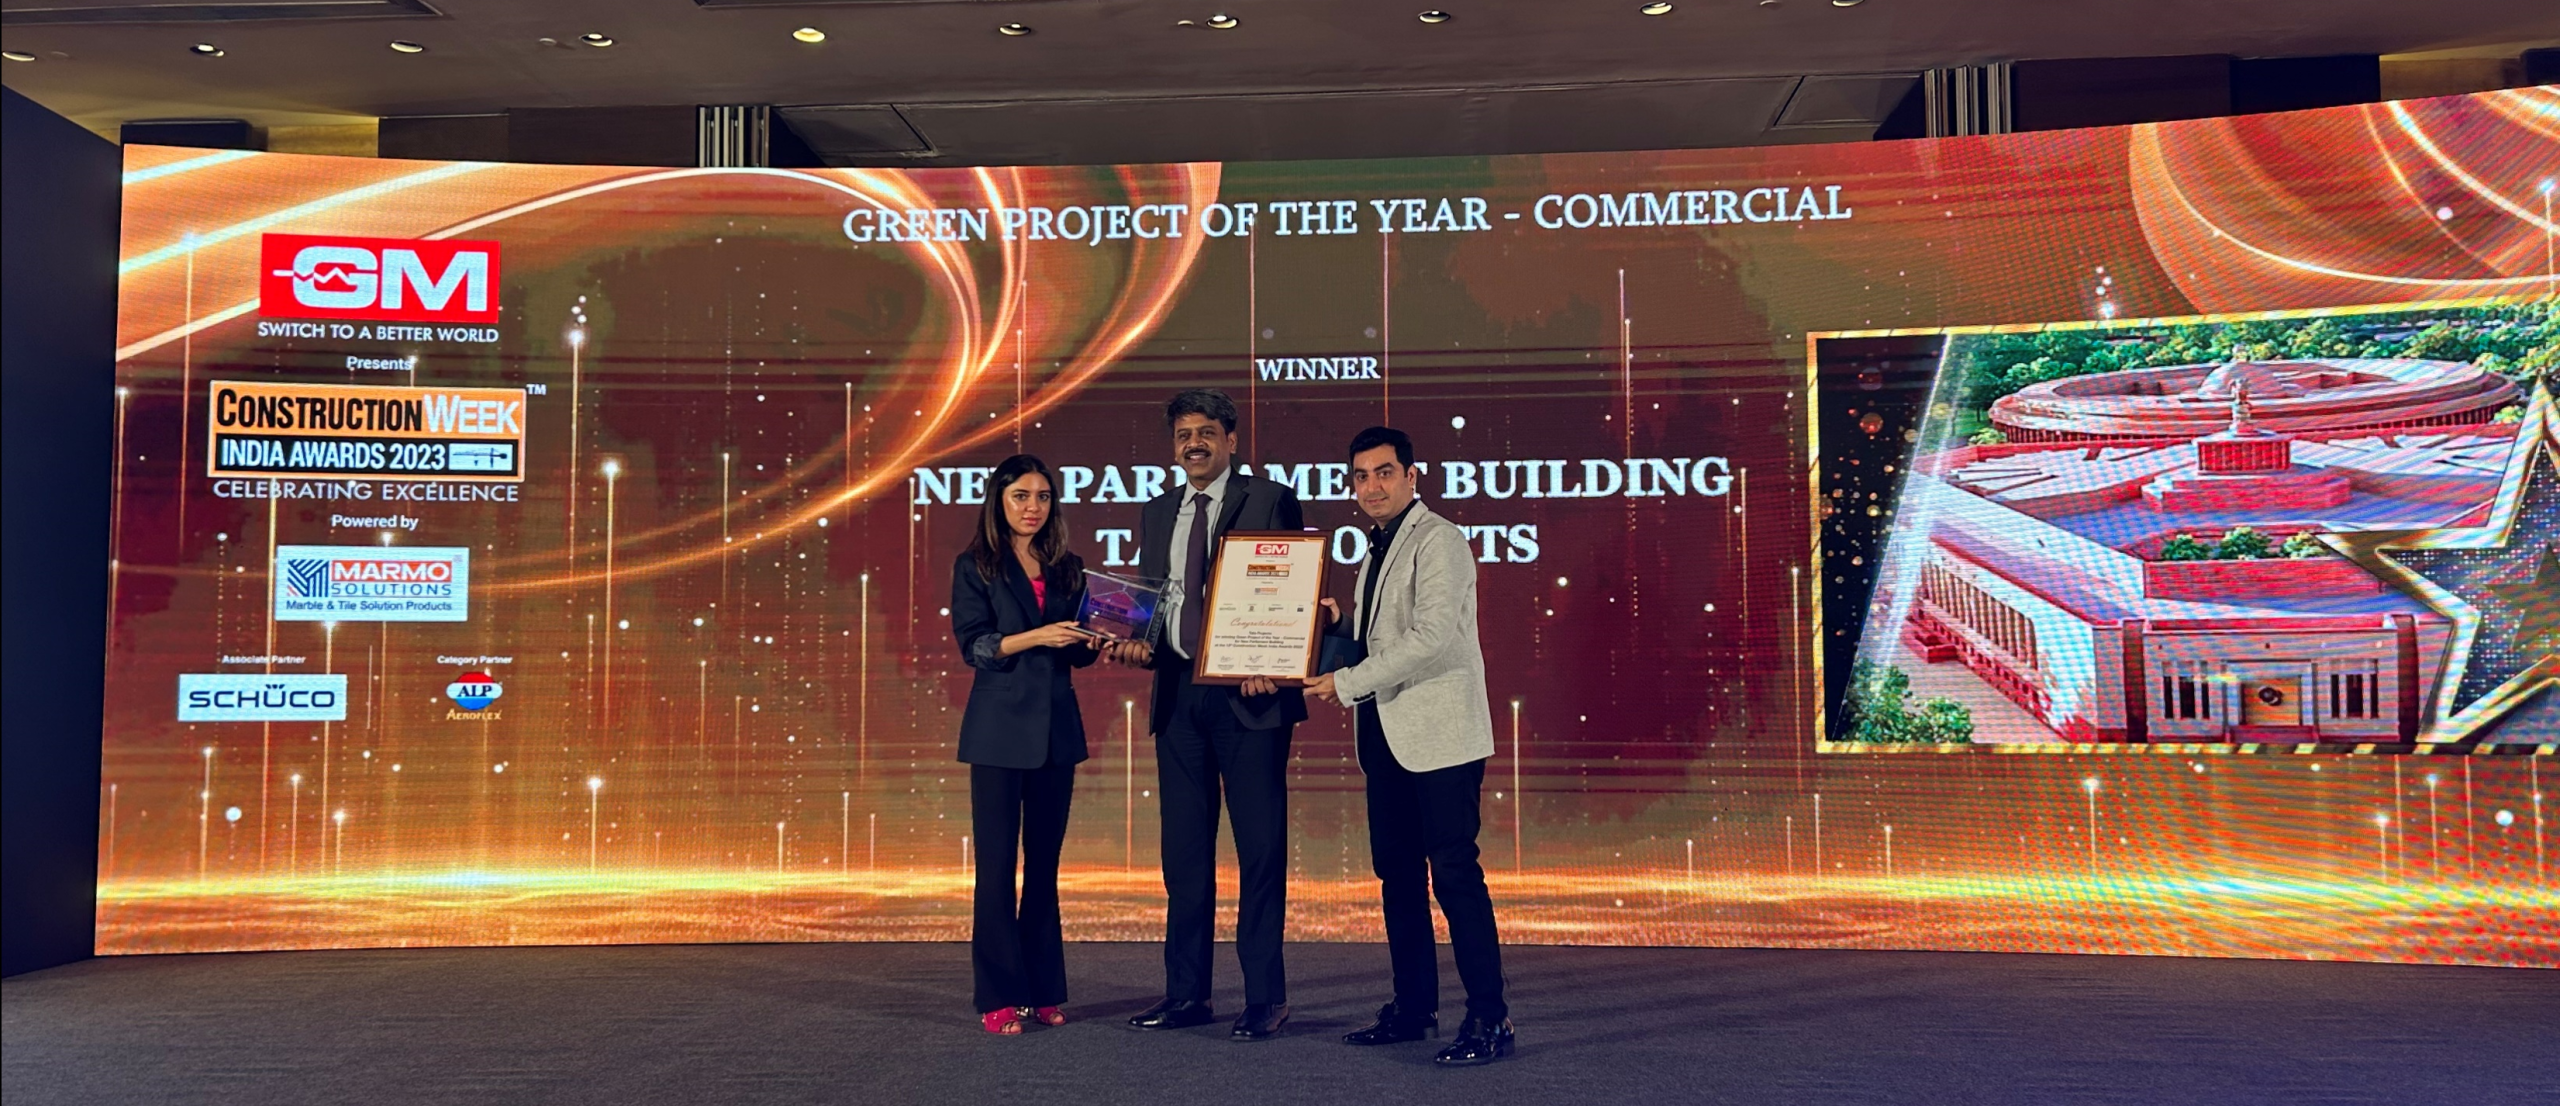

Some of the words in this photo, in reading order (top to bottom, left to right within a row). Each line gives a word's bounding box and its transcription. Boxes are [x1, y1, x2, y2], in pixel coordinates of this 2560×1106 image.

[842, 206, 990, 242] GREEN
[1002, 203, 1189, 247] PROJECT
[1200, 202, 1259, 237] OF
[1270, 200, 1358, 236] THE
[1373, 197, 1493, 233] YEAR
[1533, 184, 1853, 229] COMMERCIAL
[291, 245, 489, 312] GM
[258, 322, 325, 339] SWITCH
[330, 324, 355, 340] TO
[358, 325, 372, 340] A
[376, 325, 433, 341] BETTER
[437, 327, 499, 343] WORLD
[346, 355, 414, 371] Presents
[1255, 356, 1382, 382] WINNER
[221, 439, 286, 467] INDIA
[289, 441, 386, 469] AWARDS
[388, 442, 446, 470] 2023
[913, 467, 997, 505] NE
[1440, 456, 1735, 500] BUILDING
[213, 480, 373, 500] CELEBRATING
[382, 482, 519, 502] EXCELLENCE
[331, 513, 398, 529] Powered
[400, 514, 420, 532] by
[1259, 544, 1288, 555] GM
[333, 562, 450, 581] MARMO
[330, 583, 452, 597] SOLUTIONS
[286, 600, 324, 611] Marble
[326, 601, 335, 611] &
[337, 600, 357, 611] Tile
[360, 600, 403, 612] Solution
[406, 601, 452, 612] Products
[271, 655, 307, 664] Partner
[437, 655, 478, 666] Category
[479, 655, 513, 664] Partner
[188, 683, 336, 709] SCHÜCO
[456, 684, 493, 698] ALP
